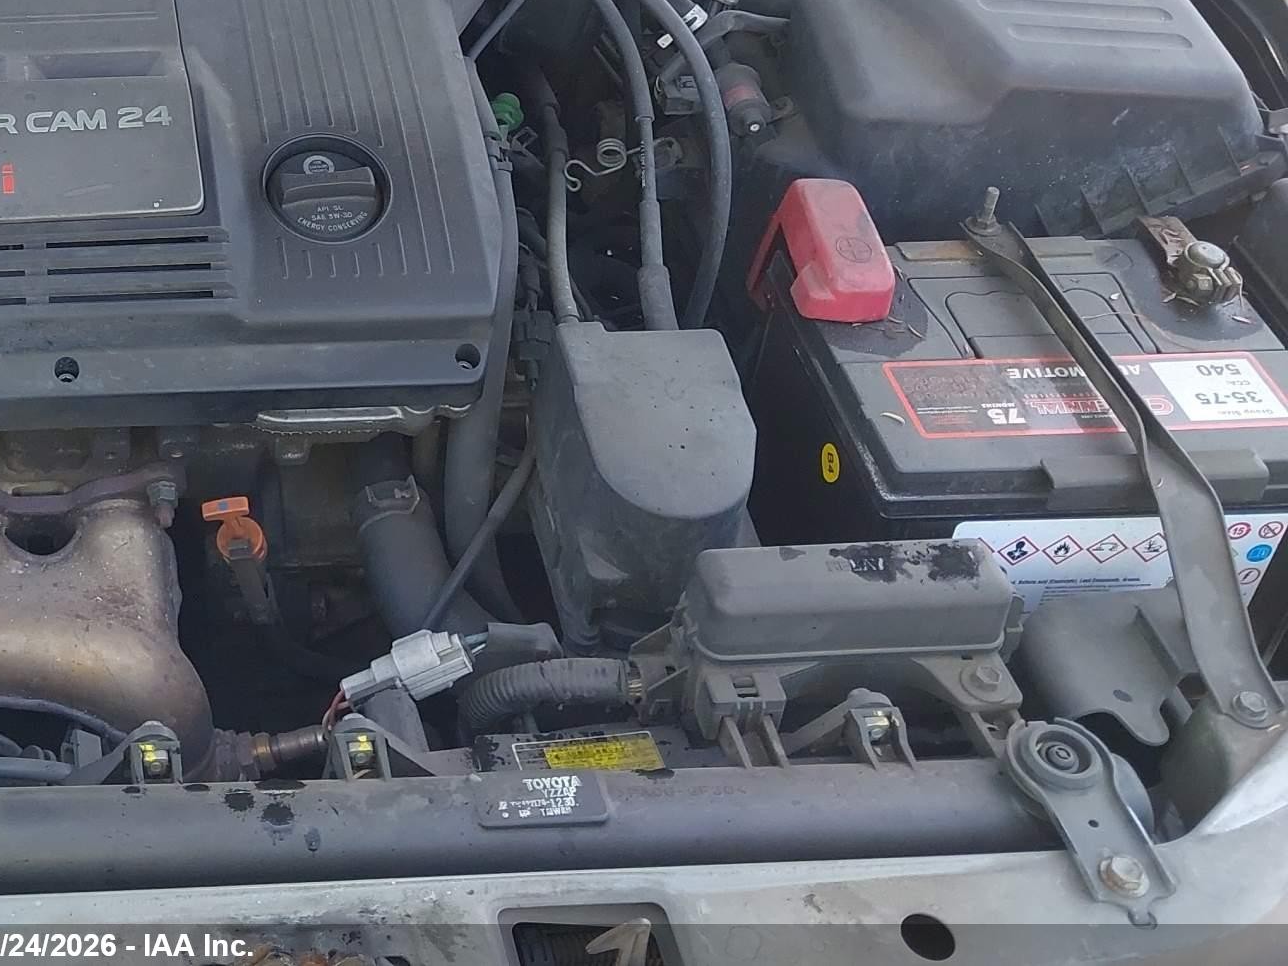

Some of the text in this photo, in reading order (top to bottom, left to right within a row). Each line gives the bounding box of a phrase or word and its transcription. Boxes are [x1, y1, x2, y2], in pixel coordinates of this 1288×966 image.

[26, 108, 108, 132] CAM
[117, 106, 172, 129] 24
[1196, 363, 1242, 377] 540
[1194, 390, 1263, 406] 35-75
[986, 408, 1027, 425] 75
[522, 775, 583, 791] TOYOTA
